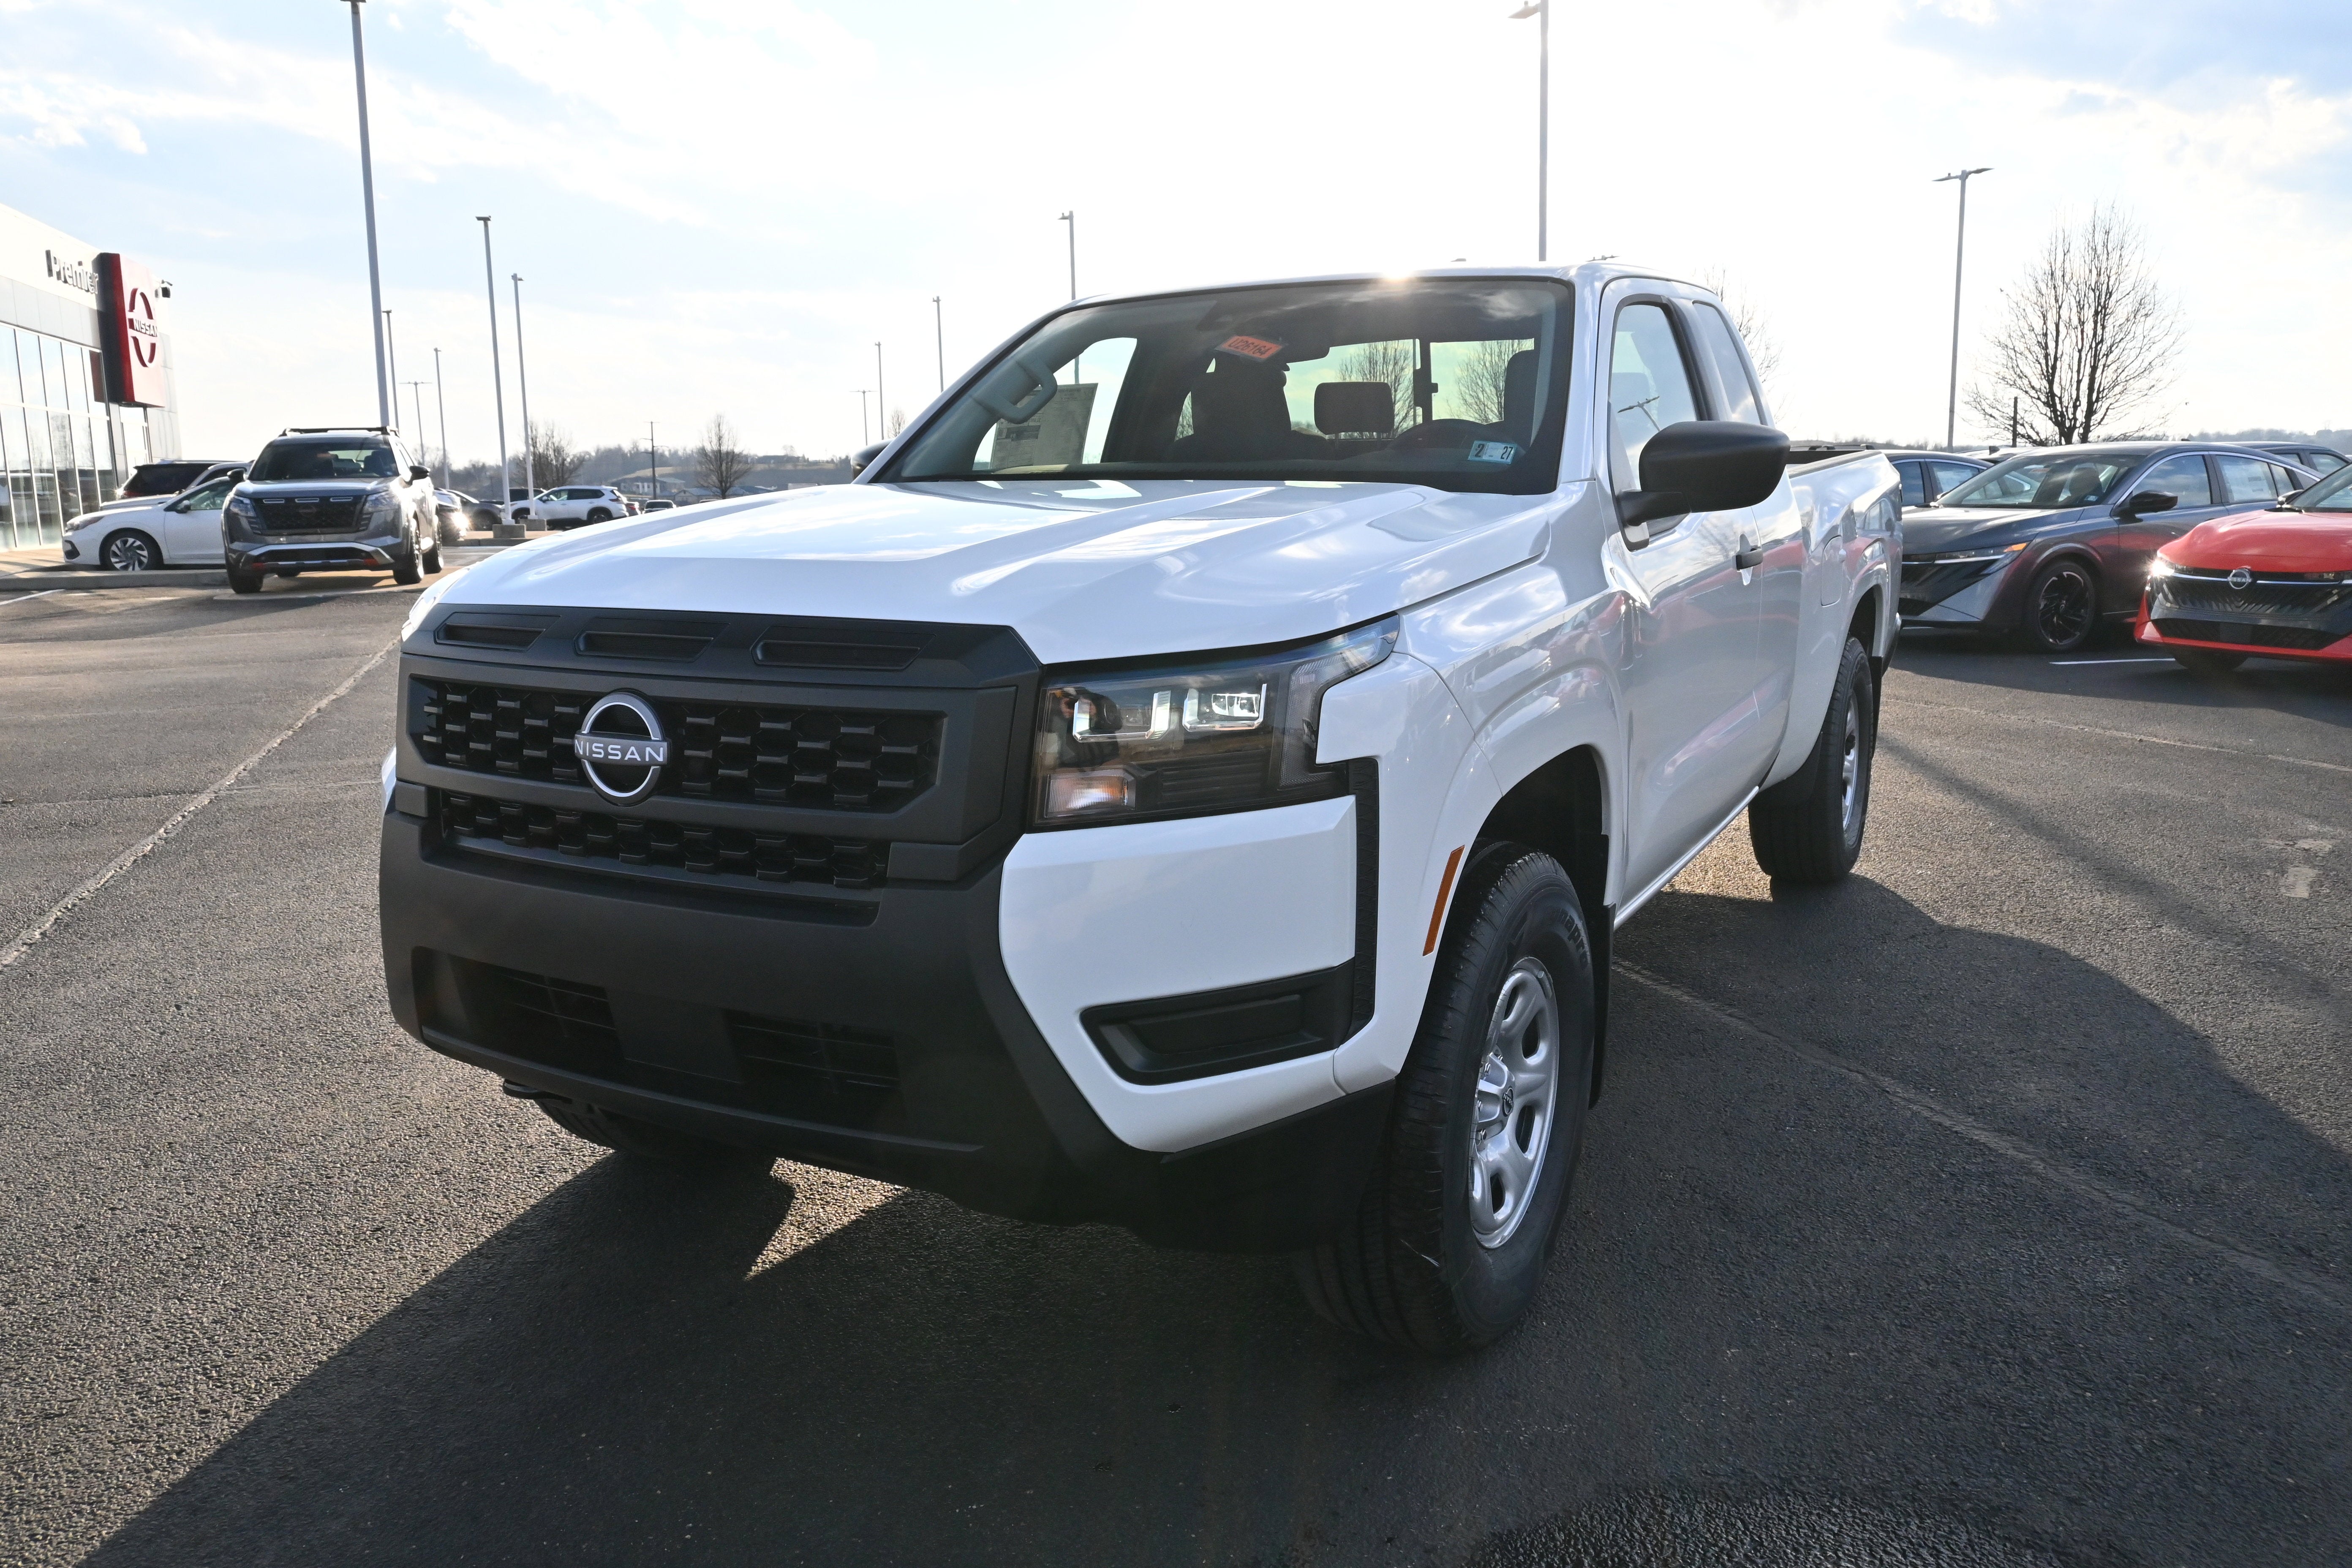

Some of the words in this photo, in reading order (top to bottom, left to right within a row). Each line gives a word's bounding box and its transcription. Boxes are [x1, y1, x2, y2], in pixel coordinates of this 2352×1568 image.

[45, 250, 98, 294] Premier
[133, 318, 158, 337] NISSAN
[1474, 444, 1485, 457] 2
[1500, 446, 1514, 460] 27
[574, 739, 663, 762] NISSAN
